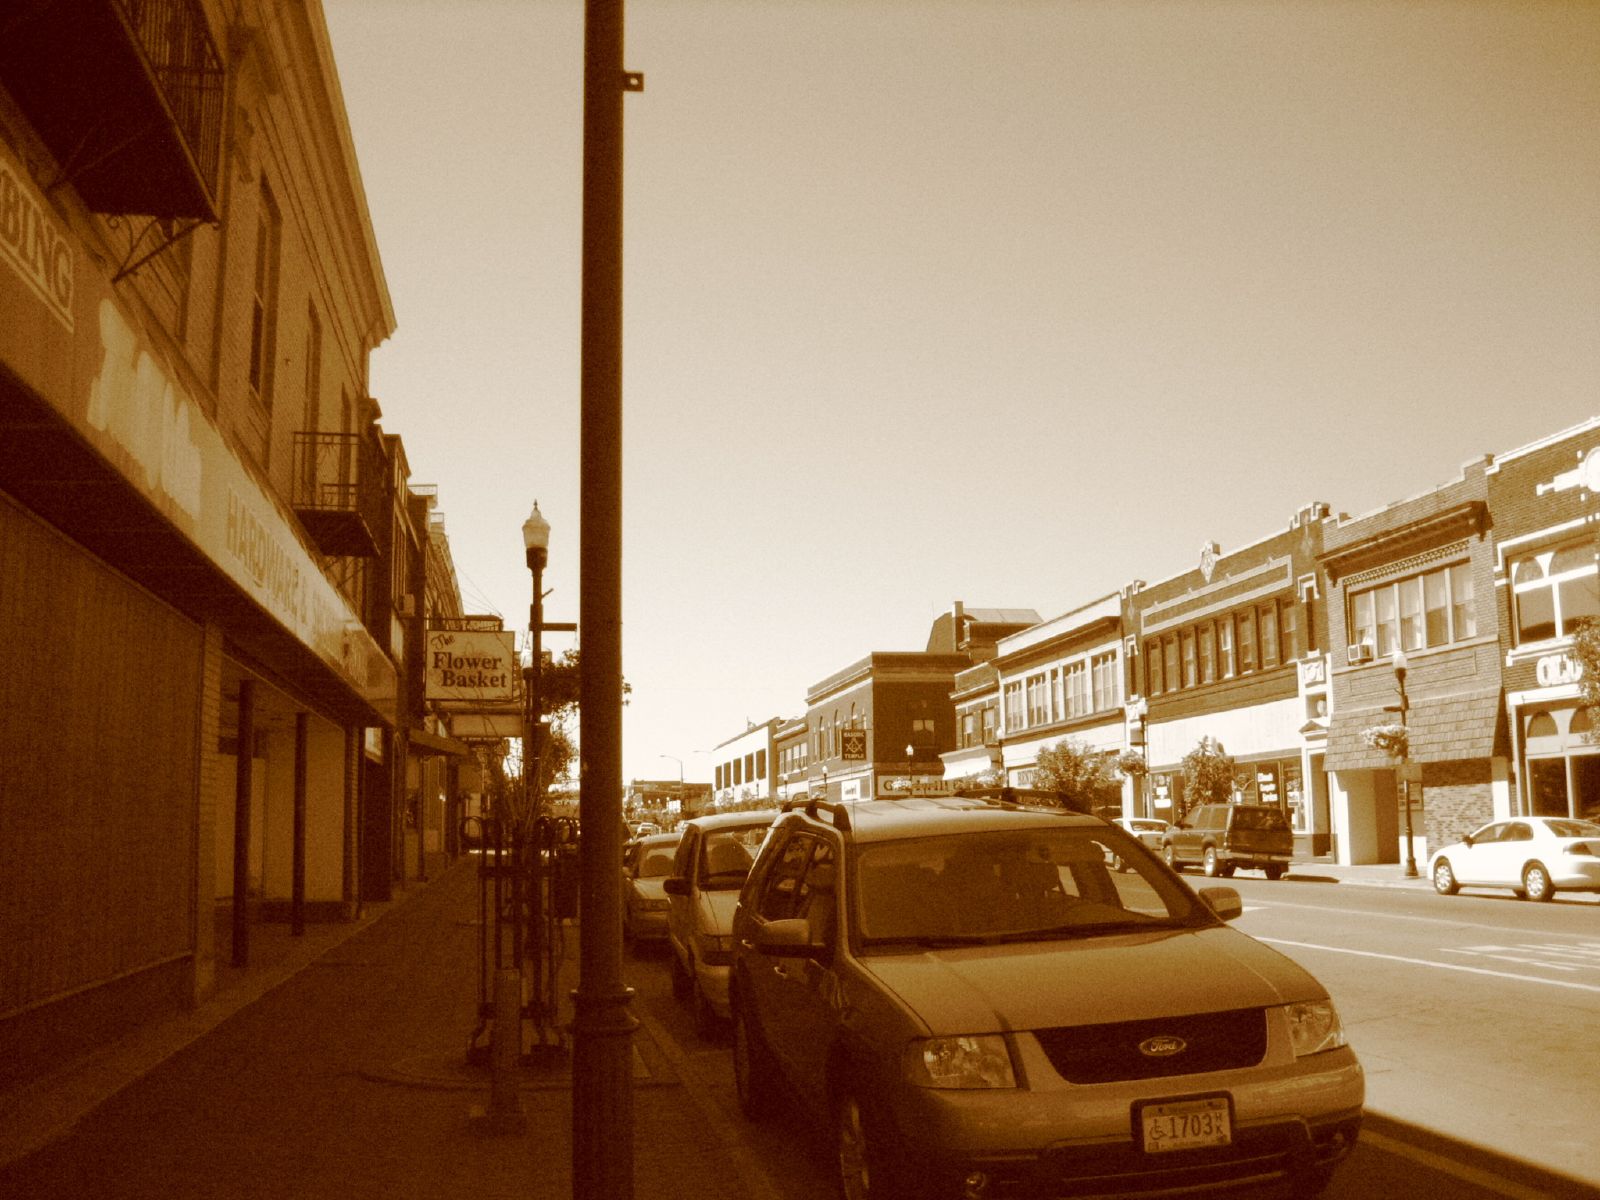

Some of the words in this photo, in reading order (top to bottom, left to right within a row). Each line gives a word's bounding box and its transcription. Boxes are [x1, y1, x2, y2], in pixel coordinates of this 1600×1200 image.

[227, 483, 298, 617] HARDWARE
[430, 633, 456, 650] The
[432, 651, 502, 670] Flower
[441, 669, 508, 688] Basket
[1150, 1038, 1177, 1052] Ford
[1168, 1112, 1214, 1139] 1703
